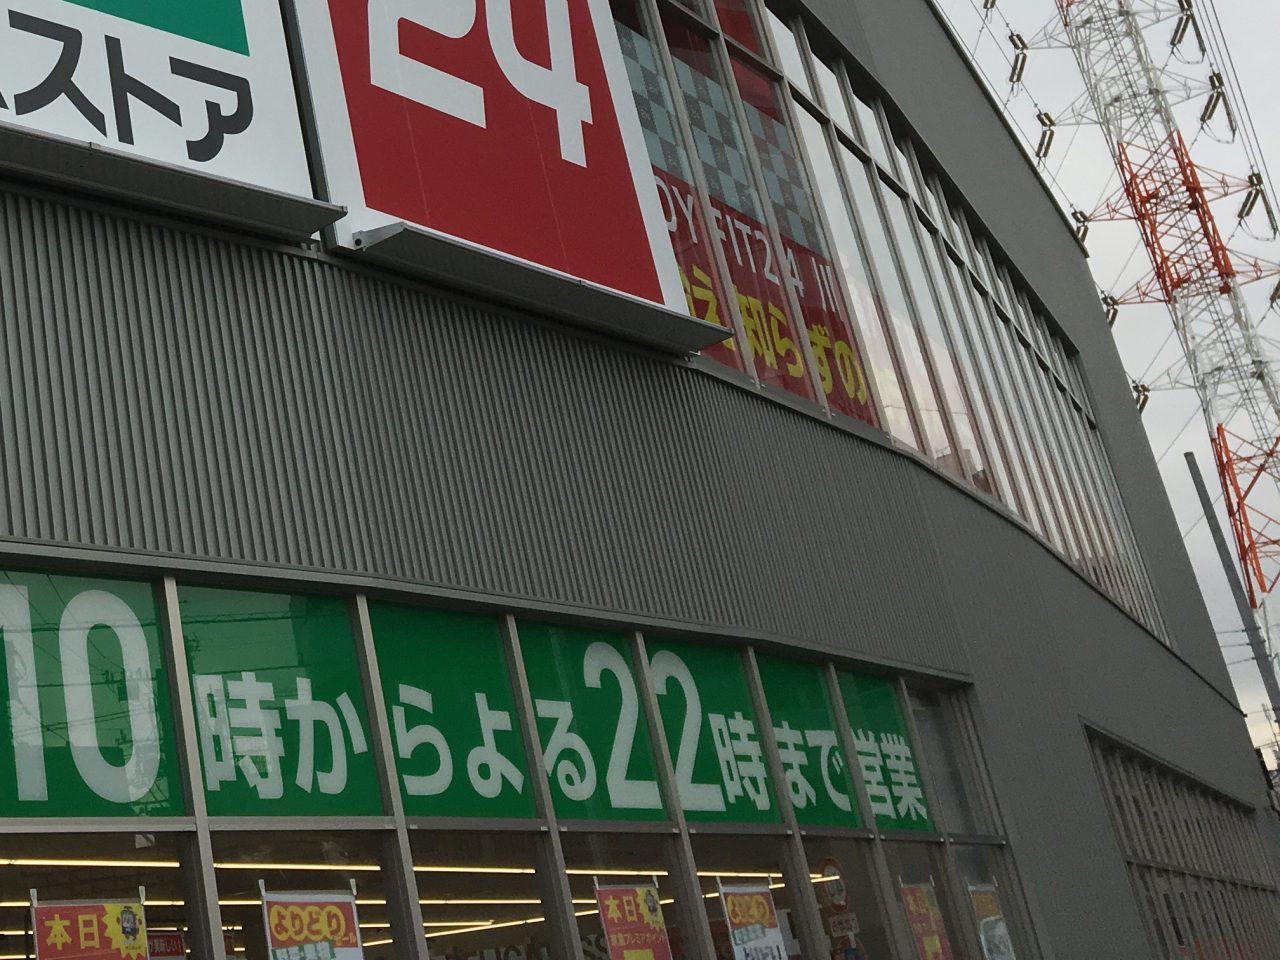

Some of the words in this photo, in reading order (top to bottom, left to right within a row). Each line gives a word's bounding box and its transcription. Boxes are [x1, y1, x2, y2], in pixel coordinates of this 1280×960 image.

[45, 914, 101, 950] 本日
[271, 905, 345, 941] よりどり
